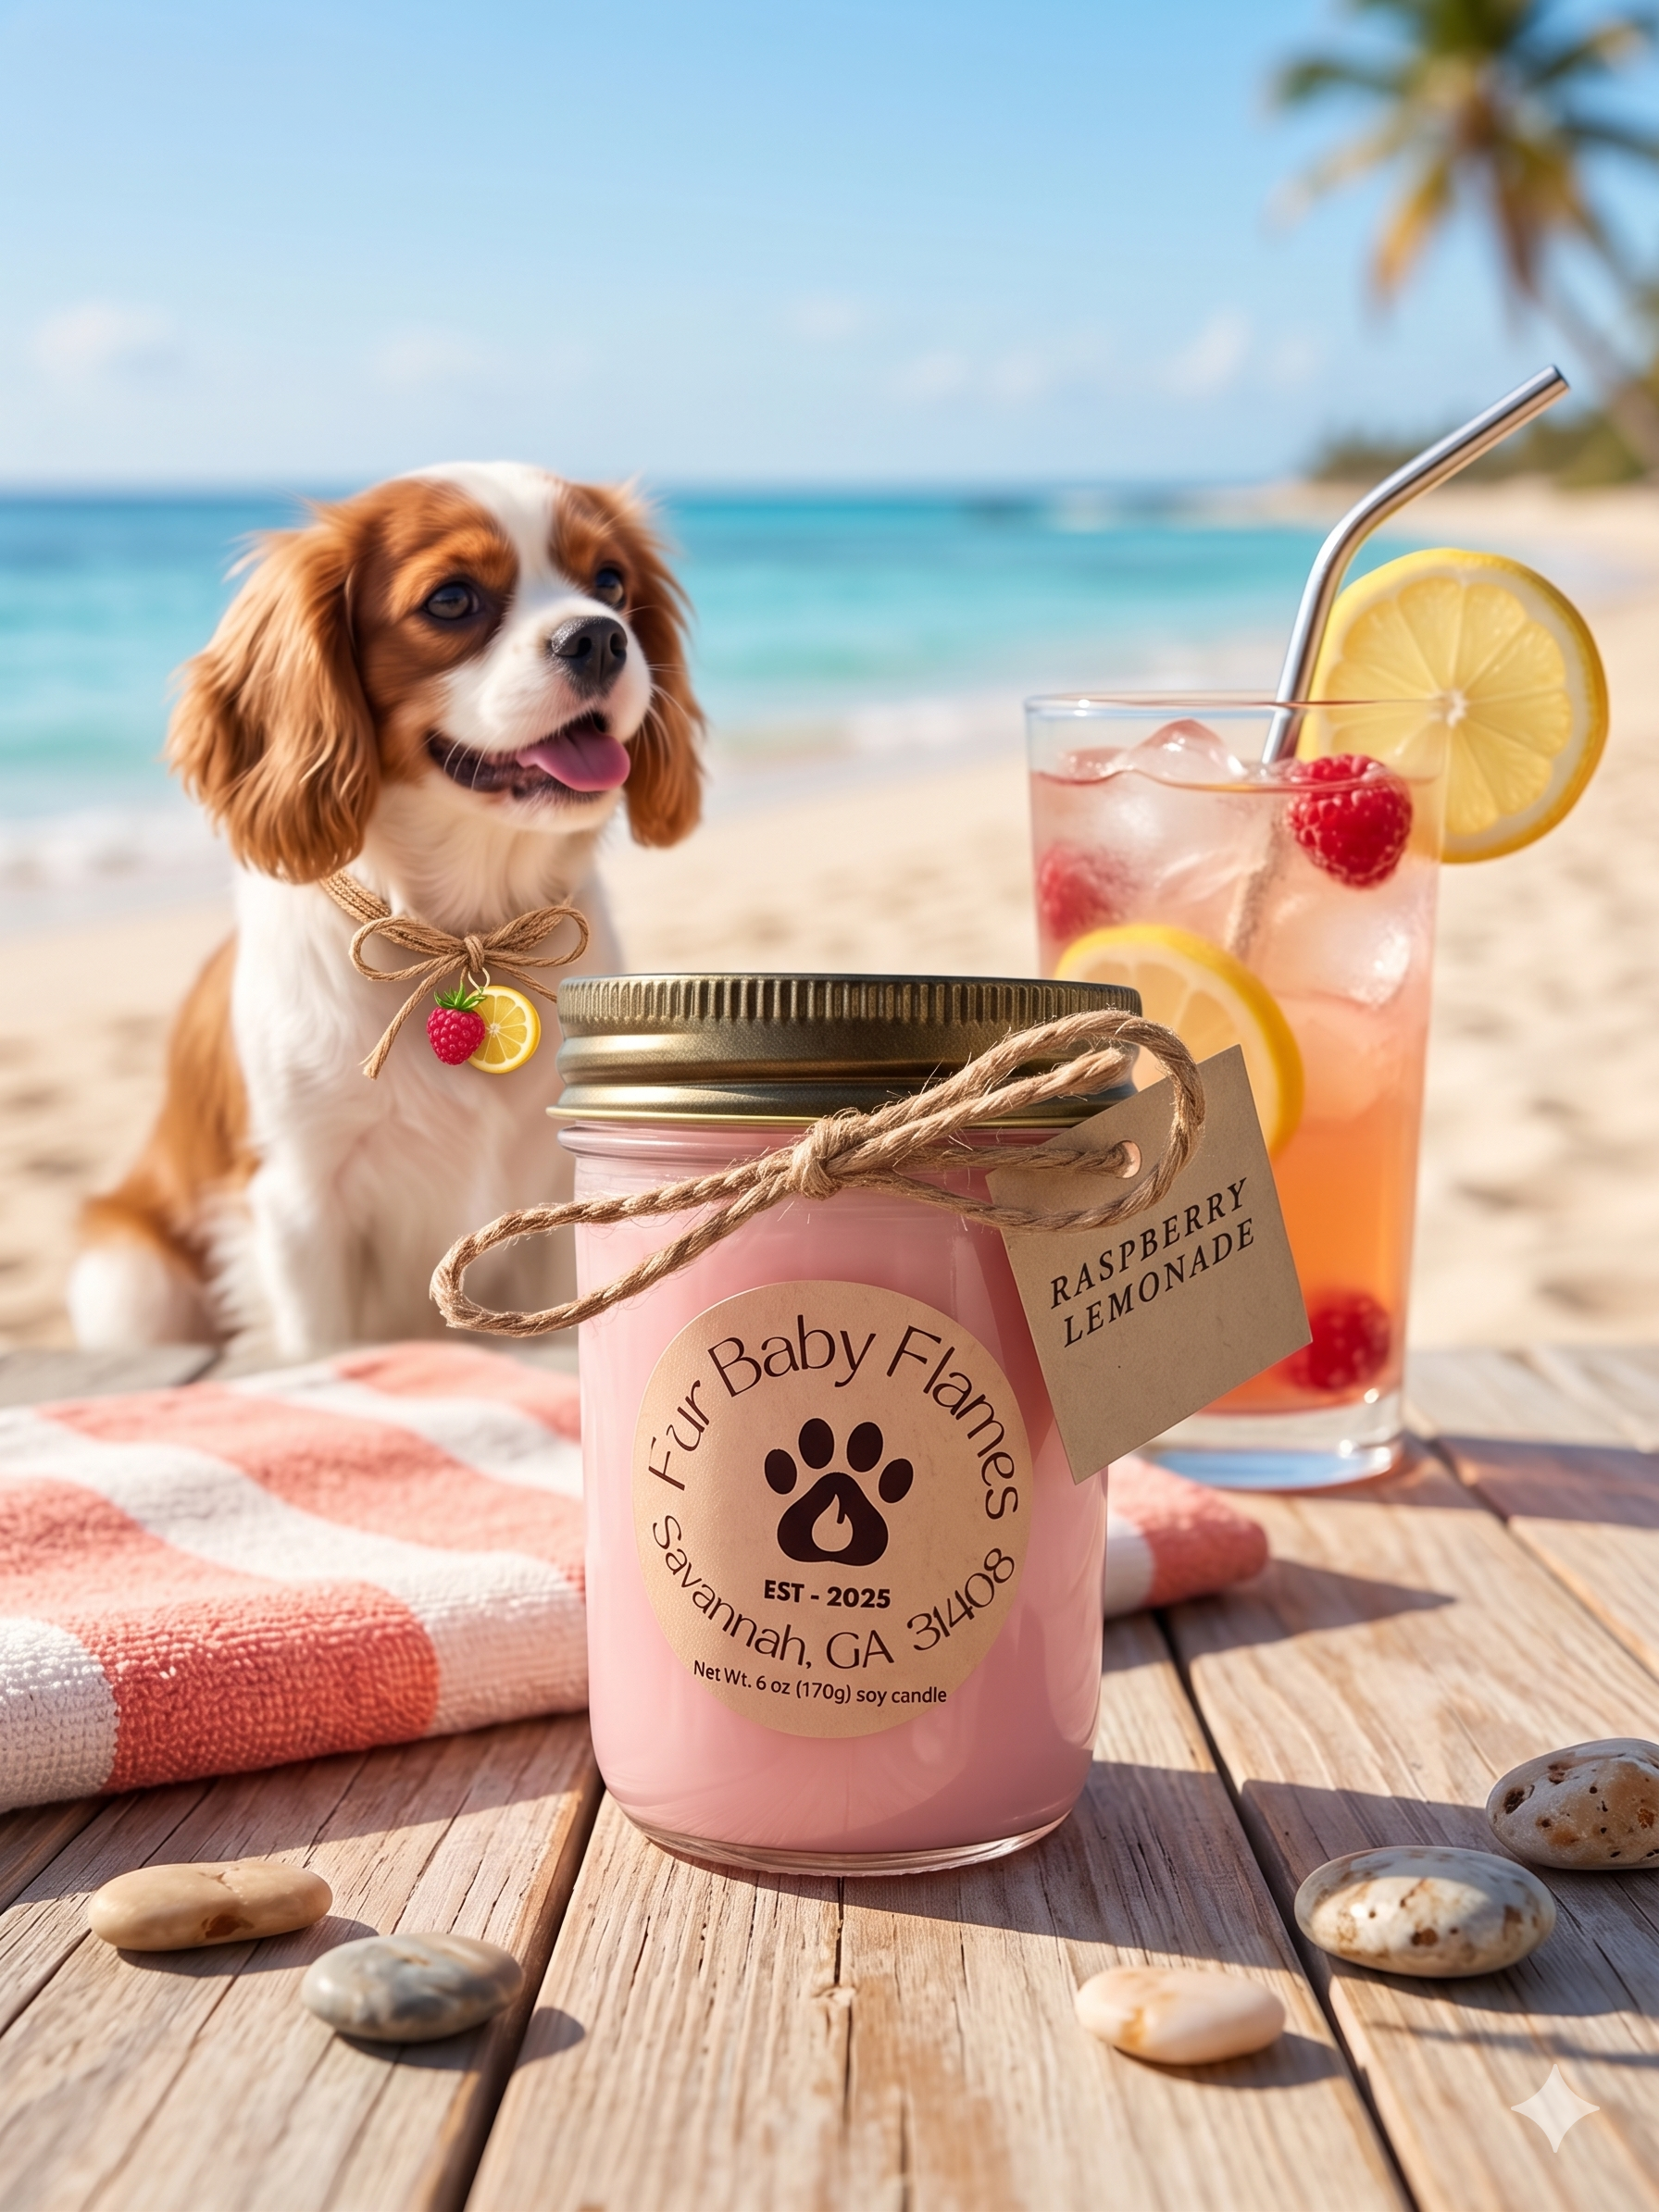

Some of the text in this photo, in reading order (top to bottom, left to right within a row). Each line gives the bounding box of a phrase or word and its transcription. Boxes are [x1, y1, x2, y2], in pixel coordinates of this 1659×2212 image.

[1051, 1177, 1248, 1310] RASPBERRY
[1064, 1218, 1255, 1348] LEMONADE
[648, 1314, 1018, 1520] Fur Baby Flames
[653, 1514, 1016, 1670] Savannah, GA 31408
[764, 1580, 805, 1603] EST
[827, 1586, 892, 1609] 2025
[694, 1659, 947, 1708] Net Wt. 6 oz (170g) soy candle
